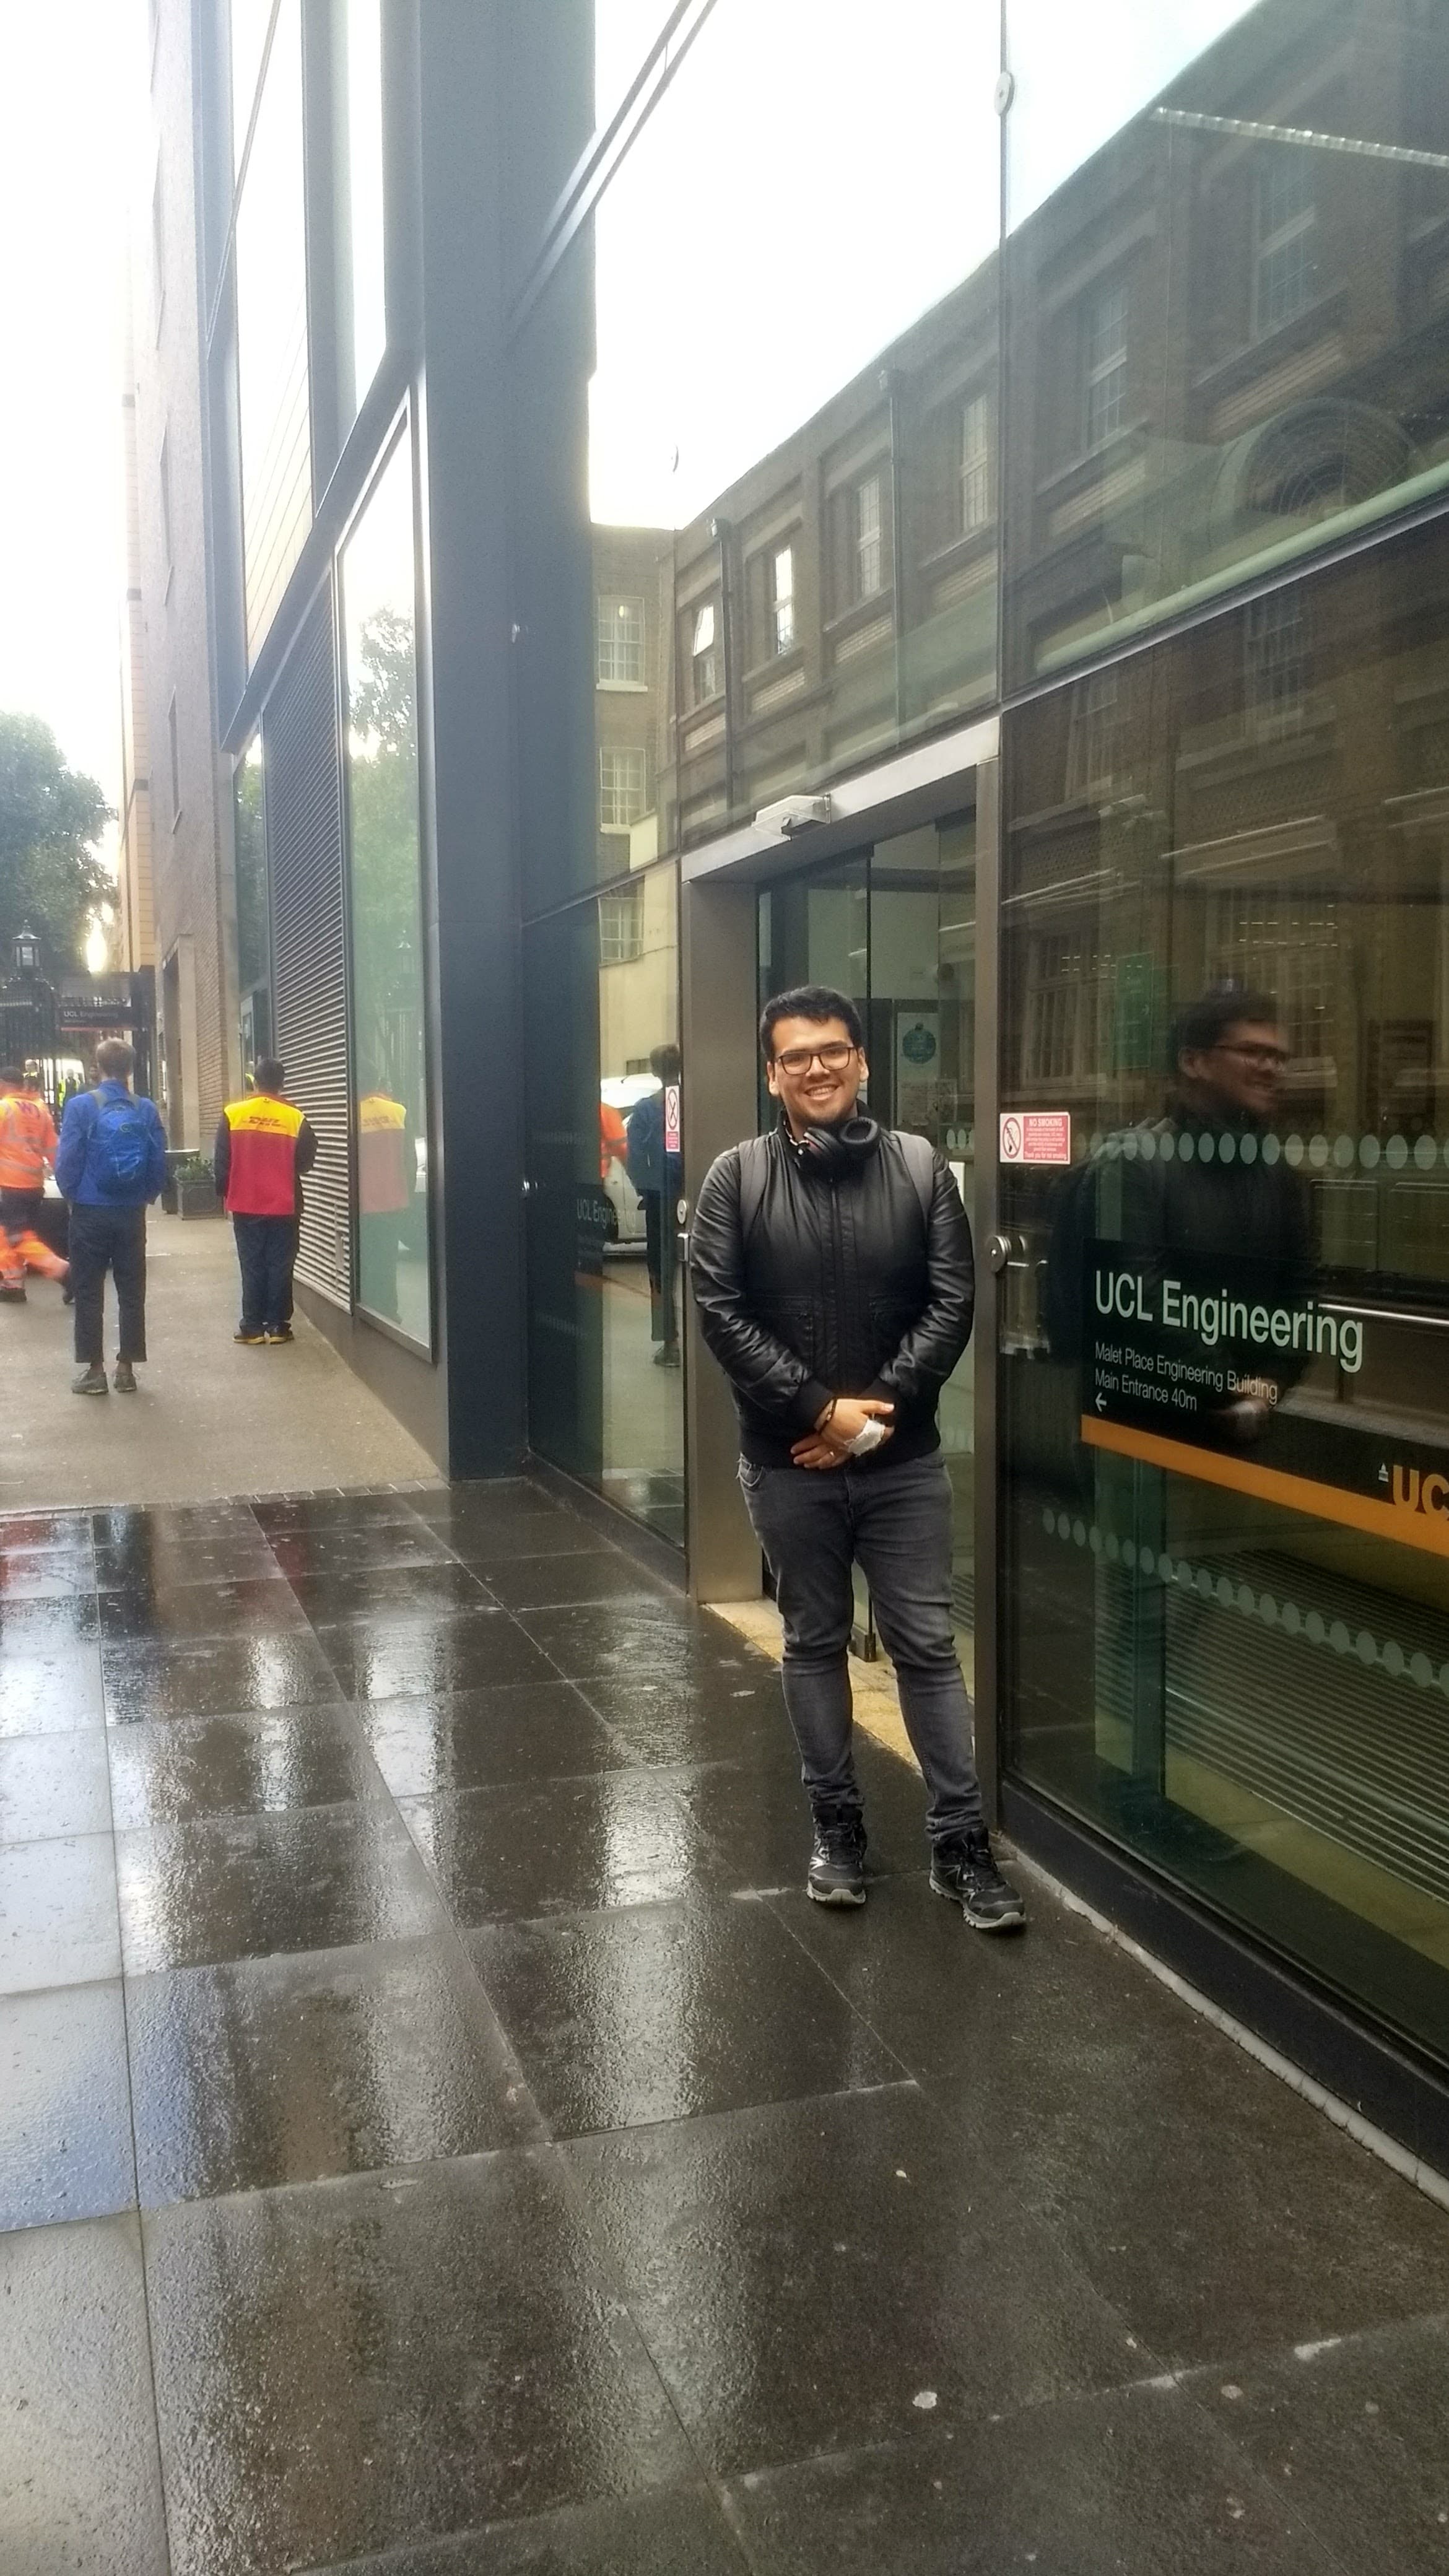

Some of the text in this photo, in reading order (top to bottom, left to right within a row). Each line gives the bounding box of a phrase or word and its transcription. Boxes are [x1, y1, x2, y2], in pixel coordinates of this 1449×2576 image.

[248, 1116, 282, 1126] DHL
[1029, 1118, 1063, 1127] NO SMOKING
[577, 1199, 592, 1221] UCL
[1095, 1269, 1364, 1373] UCL Engineering
[1095, 1341, 1278, 1406] Malet Place Engineering Building
[1095, 1367, 1198, 1411] Main Entrance 40m
